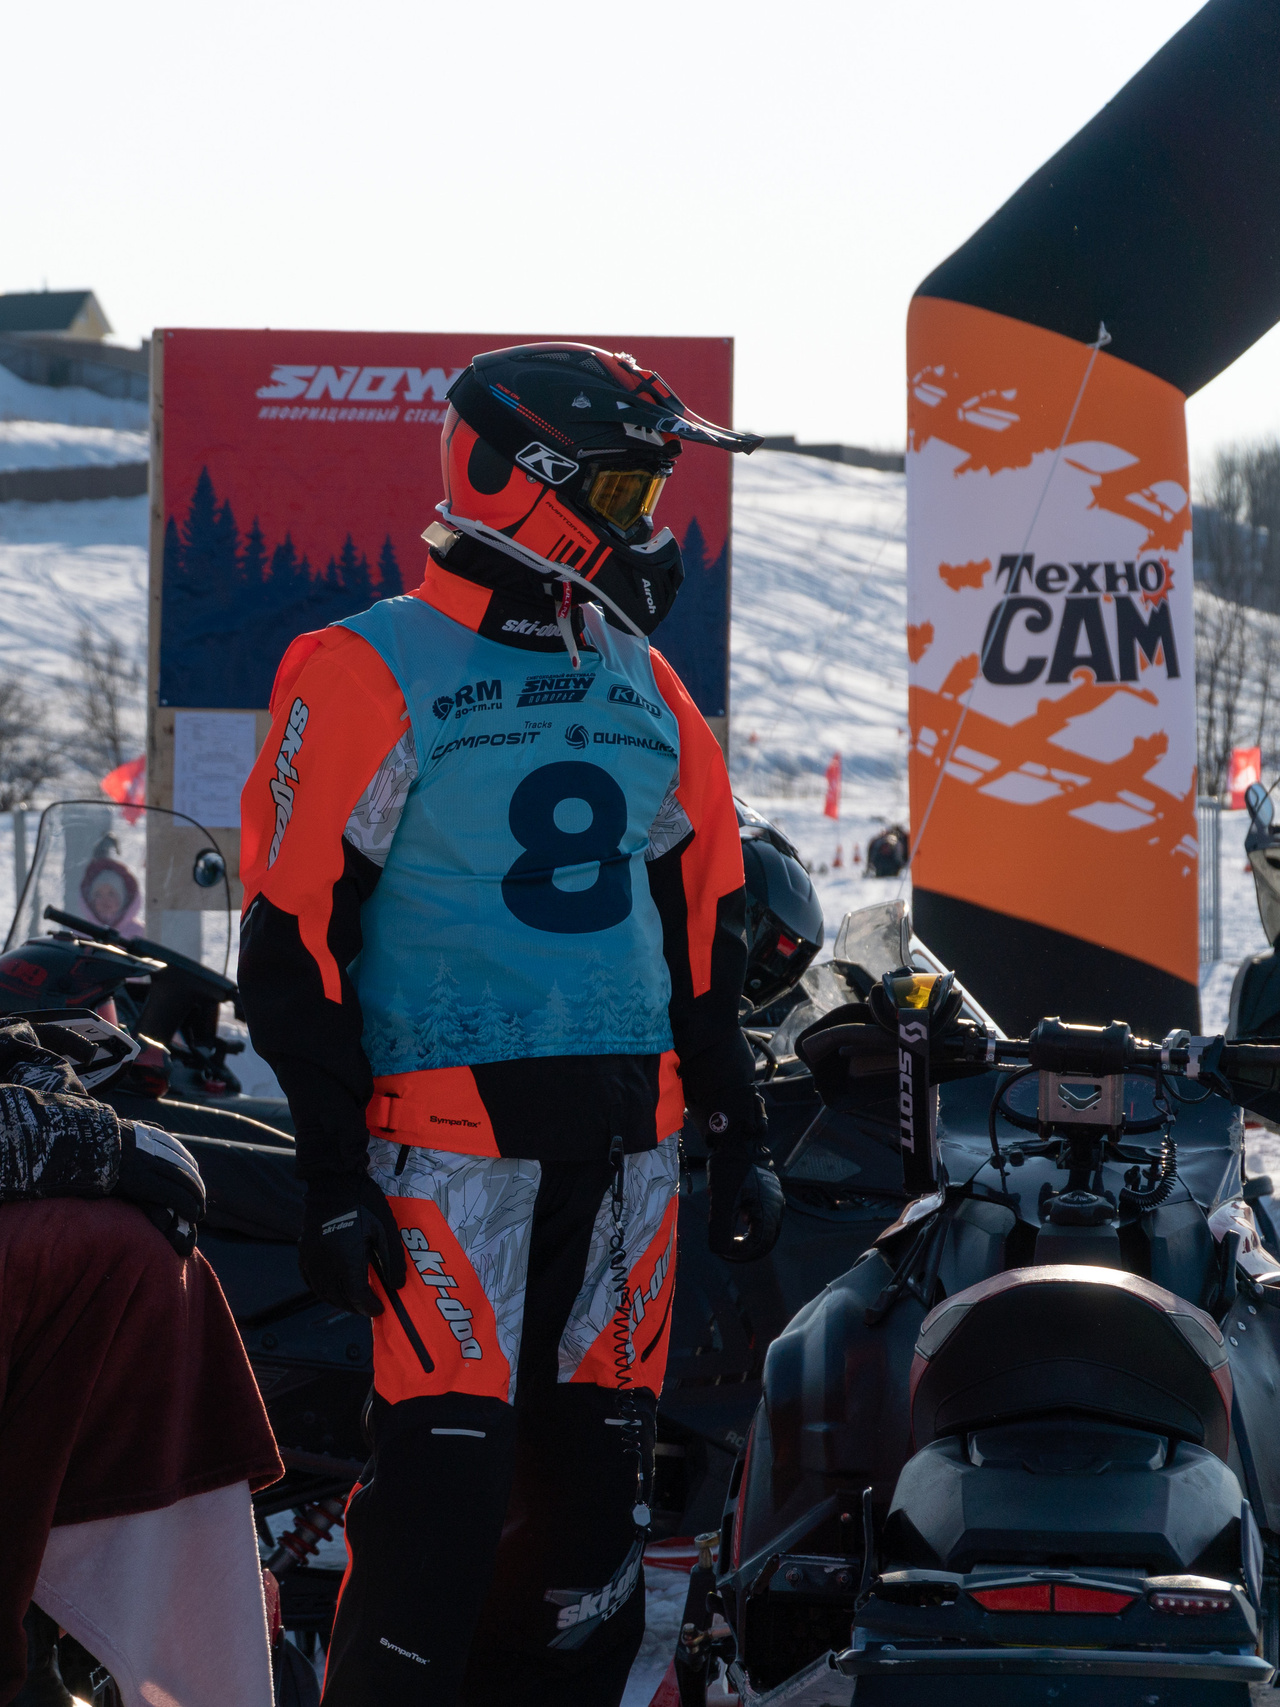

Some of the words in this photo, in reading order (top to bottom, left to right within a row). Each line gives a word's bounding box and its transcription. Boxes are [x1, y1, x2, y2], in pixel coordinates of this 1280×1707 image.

[258, 405, 400, 423] ИНФОРМАЦИОННЫЙ
[642, 578, 656, 614] Airoh
[981, 595, 1181, 685] САМ
[521, 677, 596, 693] SNOW
[455, 702, 503, 719] go-rm.ru
[524, 720, 553, 729] Tracks
[431, 731, 541, 760] COMPOSIT
[501, 760, 632, 934] 8
[899, 1047, 915, 1154] SCOTT
[400, 1231, 483, 1360] ski-doo
